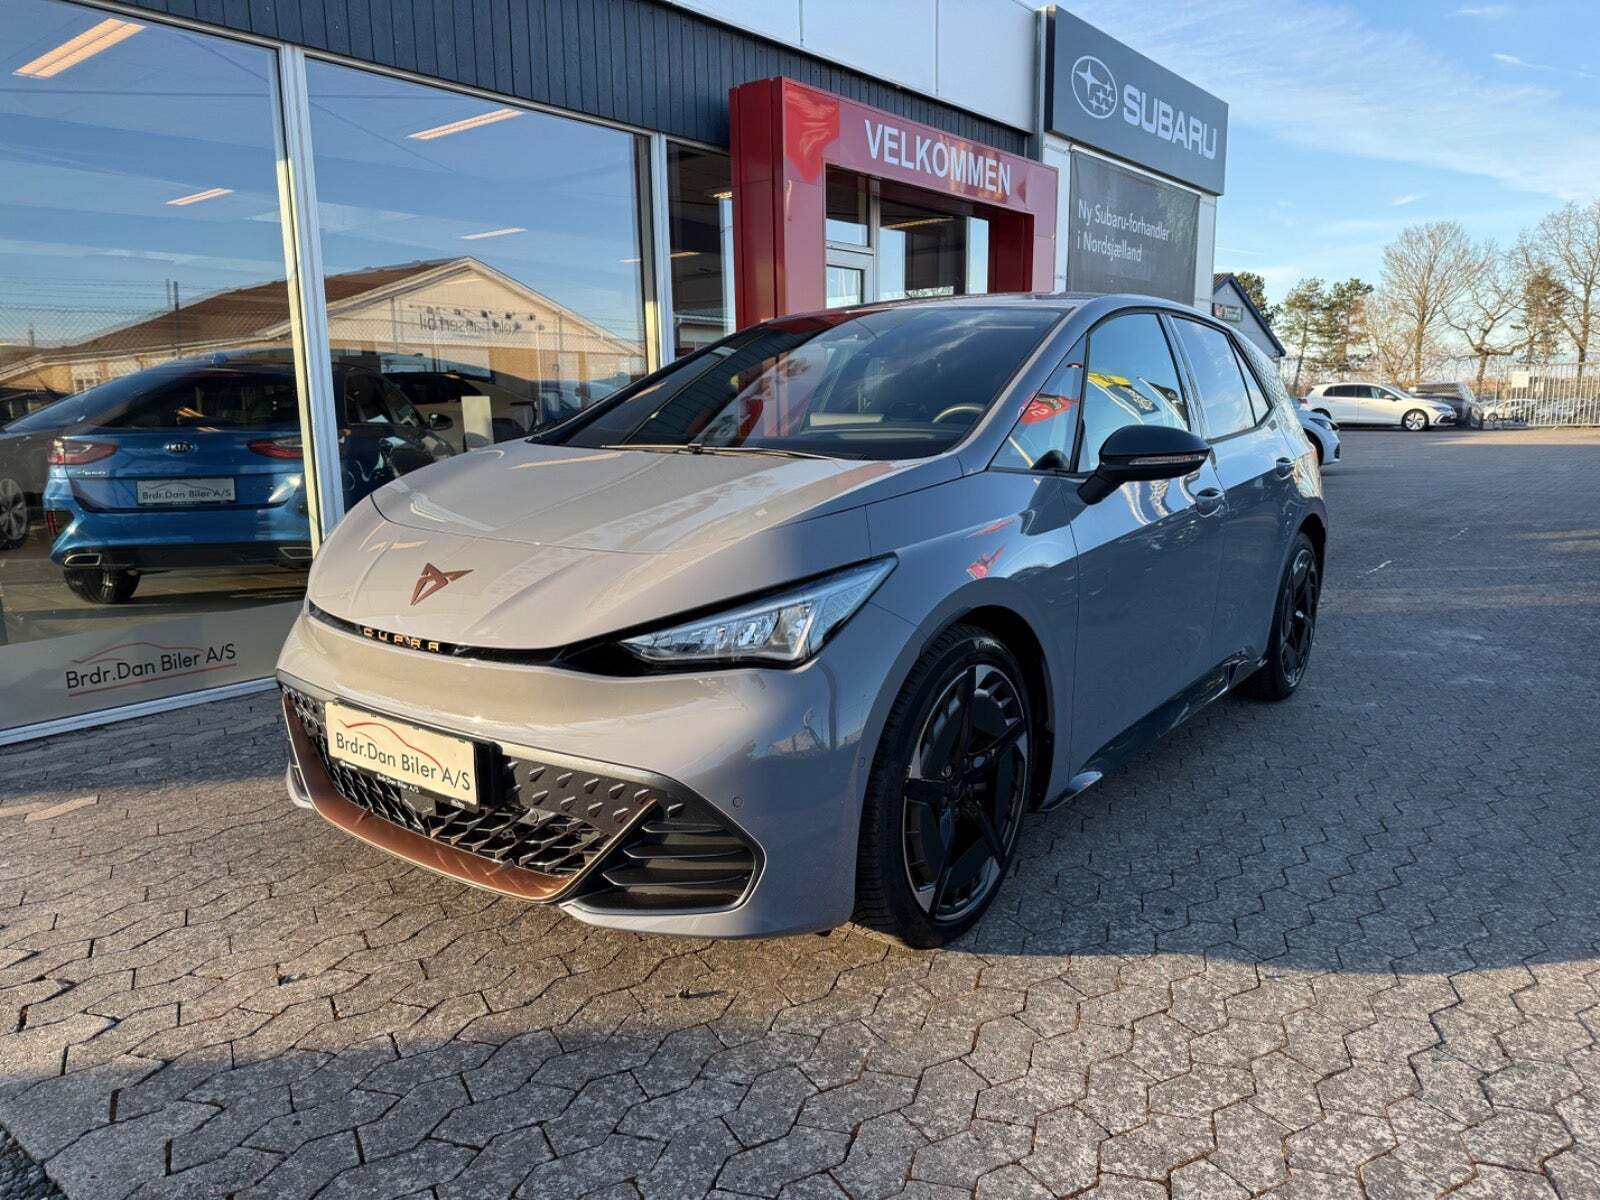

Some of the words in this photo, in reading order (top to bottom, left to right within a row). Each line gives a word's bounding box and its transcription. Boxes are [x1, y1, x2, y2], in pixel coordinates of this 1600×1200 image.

[1123, 83, 1217, 160] SUBARU
[864, 119, 1011, 196] VELKOMMEN
[1078, 199, 1093, 226] Ny
[1095, 203, 1170, 241] Subaru-forhandler
[1083, 231, 1143, 261] Nordsjælland
[188, 488, 212, 498] Biler
[213, 487, 232, 498] A/S
[363, 627, 439, 652] CUPRA
[65, 661, 156, 689] Brdr.Dan
[160, 652, 201, 672] Biler
[205, 643, 237, 663] A/S
[335, 731, 397, 768] Brdr.Dan
[401, 753, 437, 779] Biler
[441, 767, 472, 791] A/S
